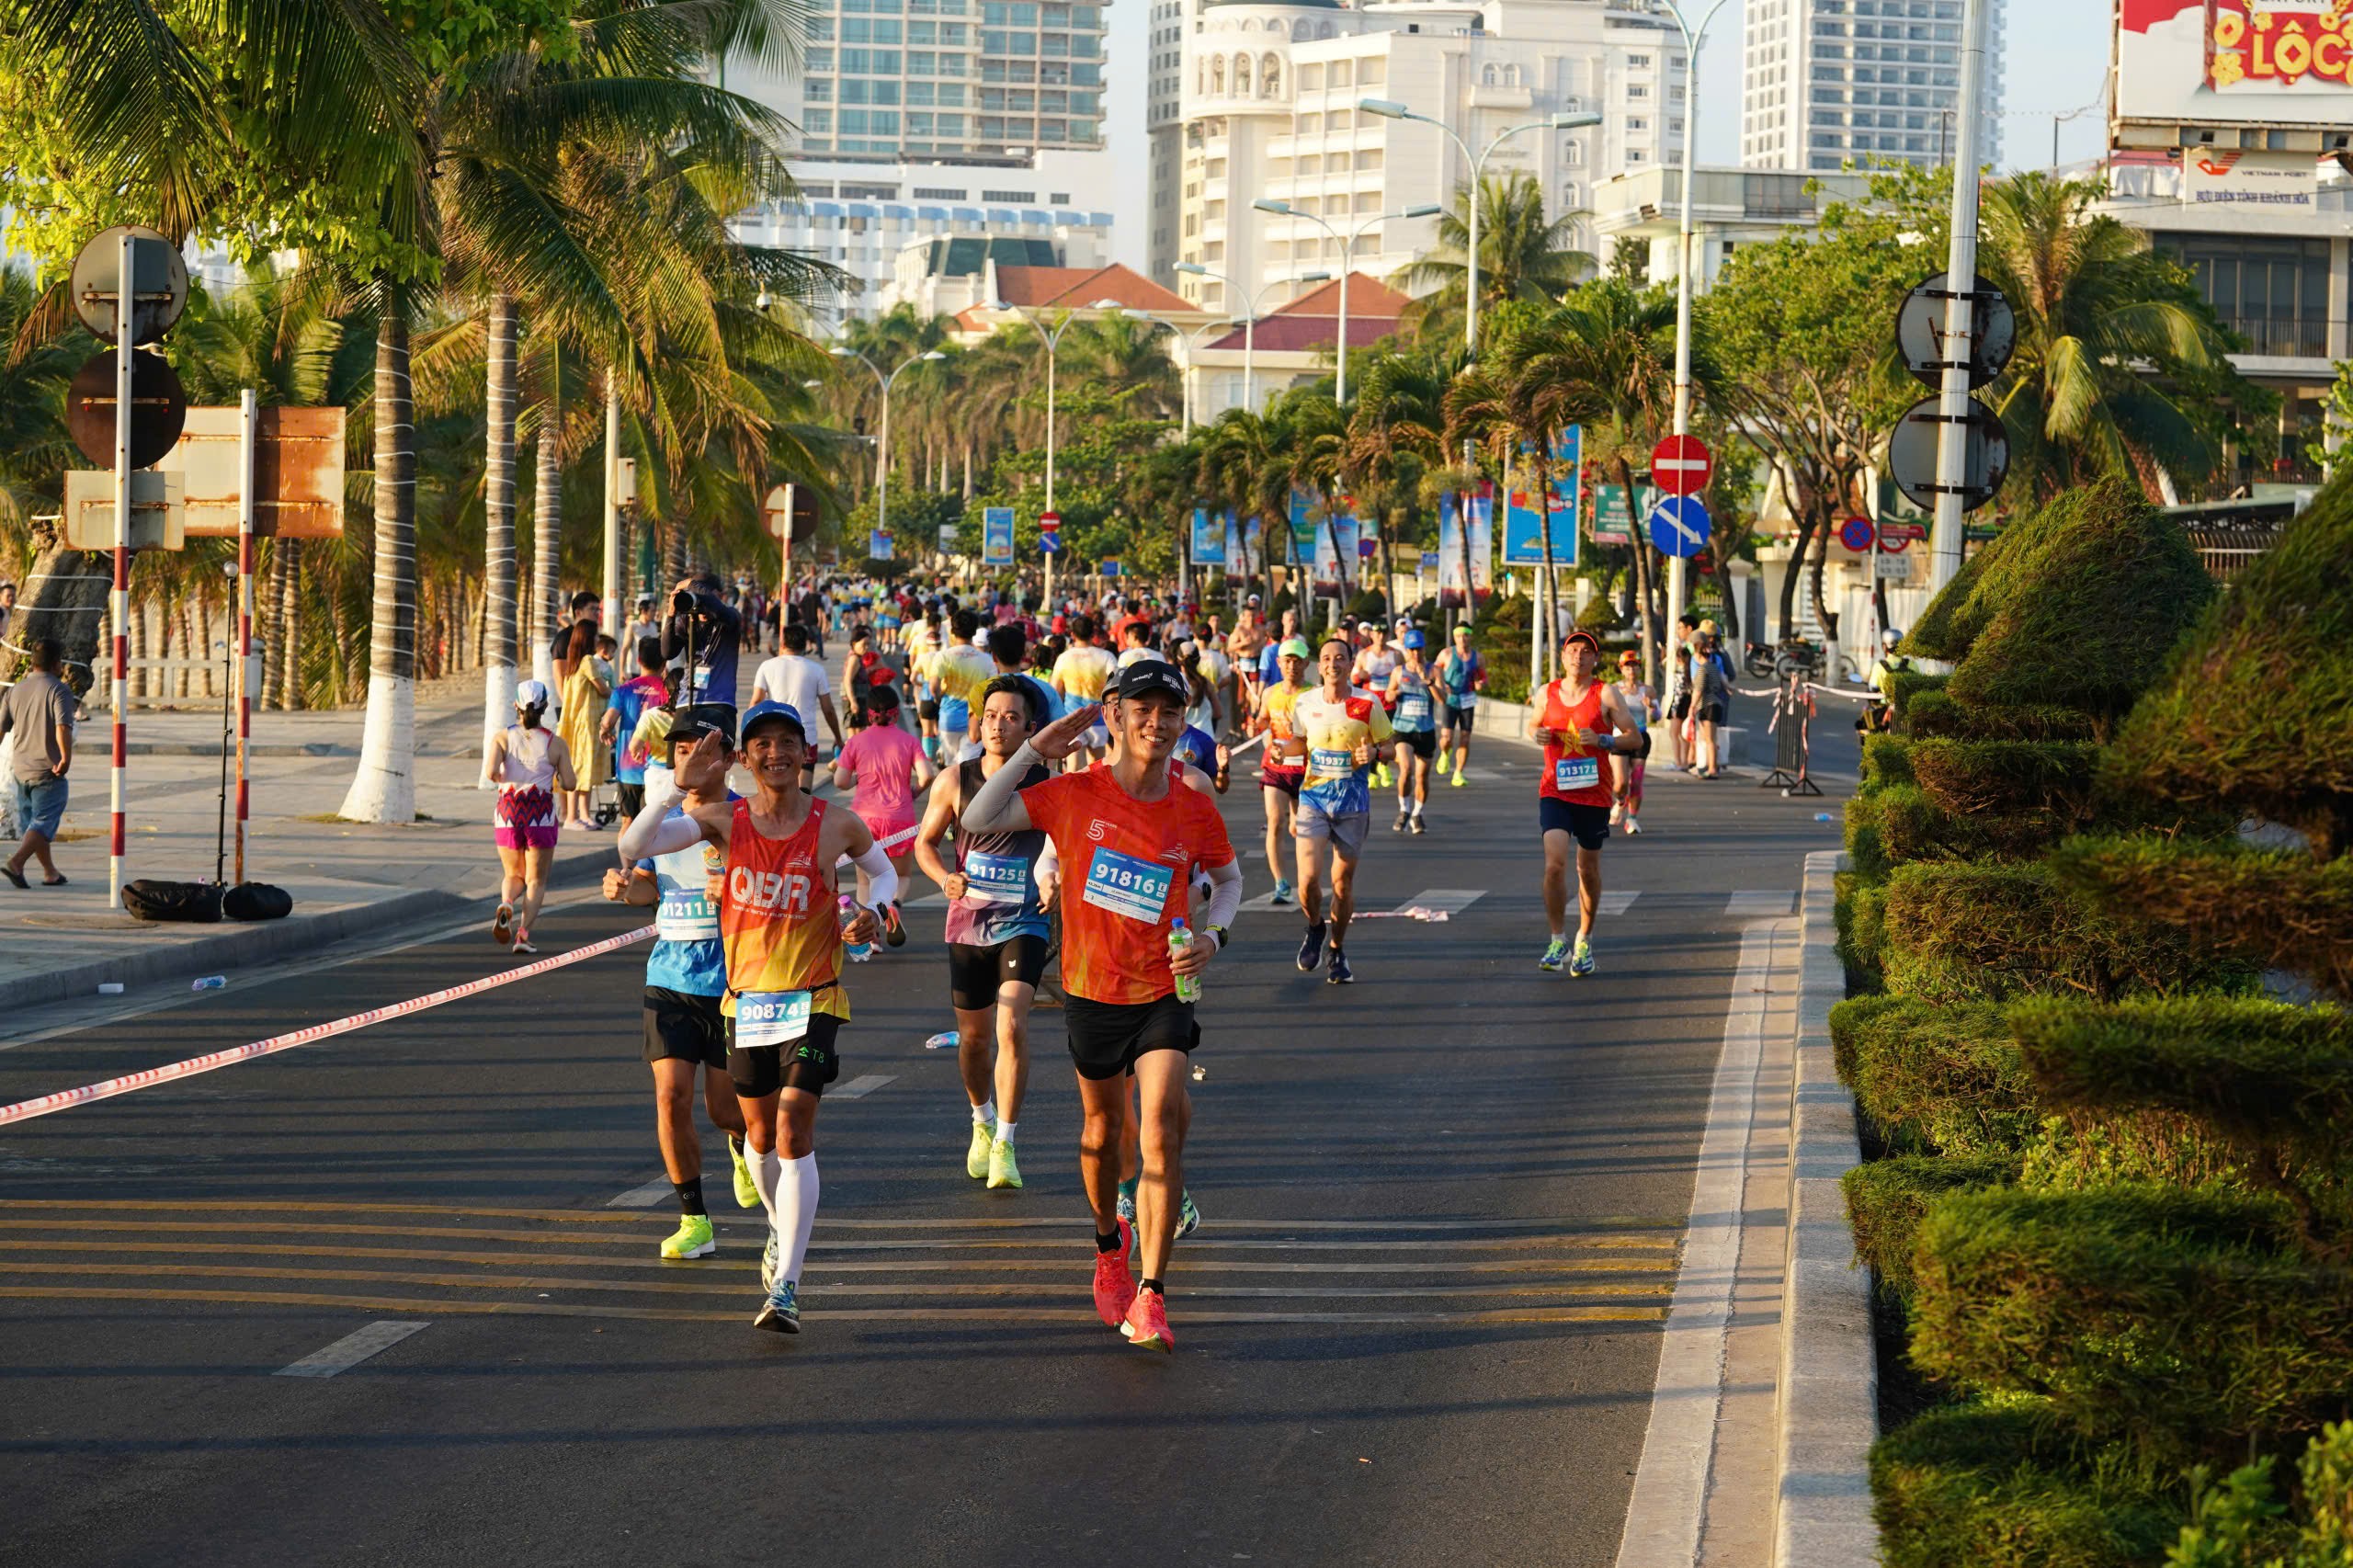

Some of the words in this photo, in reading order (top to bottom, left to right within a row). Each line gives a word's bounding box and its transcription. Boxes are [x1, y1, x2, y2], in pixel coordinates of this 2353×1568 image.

[2253, 19, 2347, 84] LỘC
[2242, 169, 2280, 177] VIETNAM
[1559, 765, 1590, 776] 91317
[1086, 819, 1105, 840] 5
[970, 863, 1016, 881] 91125
[1095, 863, 1155, 894] 91816
[730, 866, 811, 912] QBR
[663, 902, 702, 917] 91211
[741, 1003, 799, 1022] 90874
